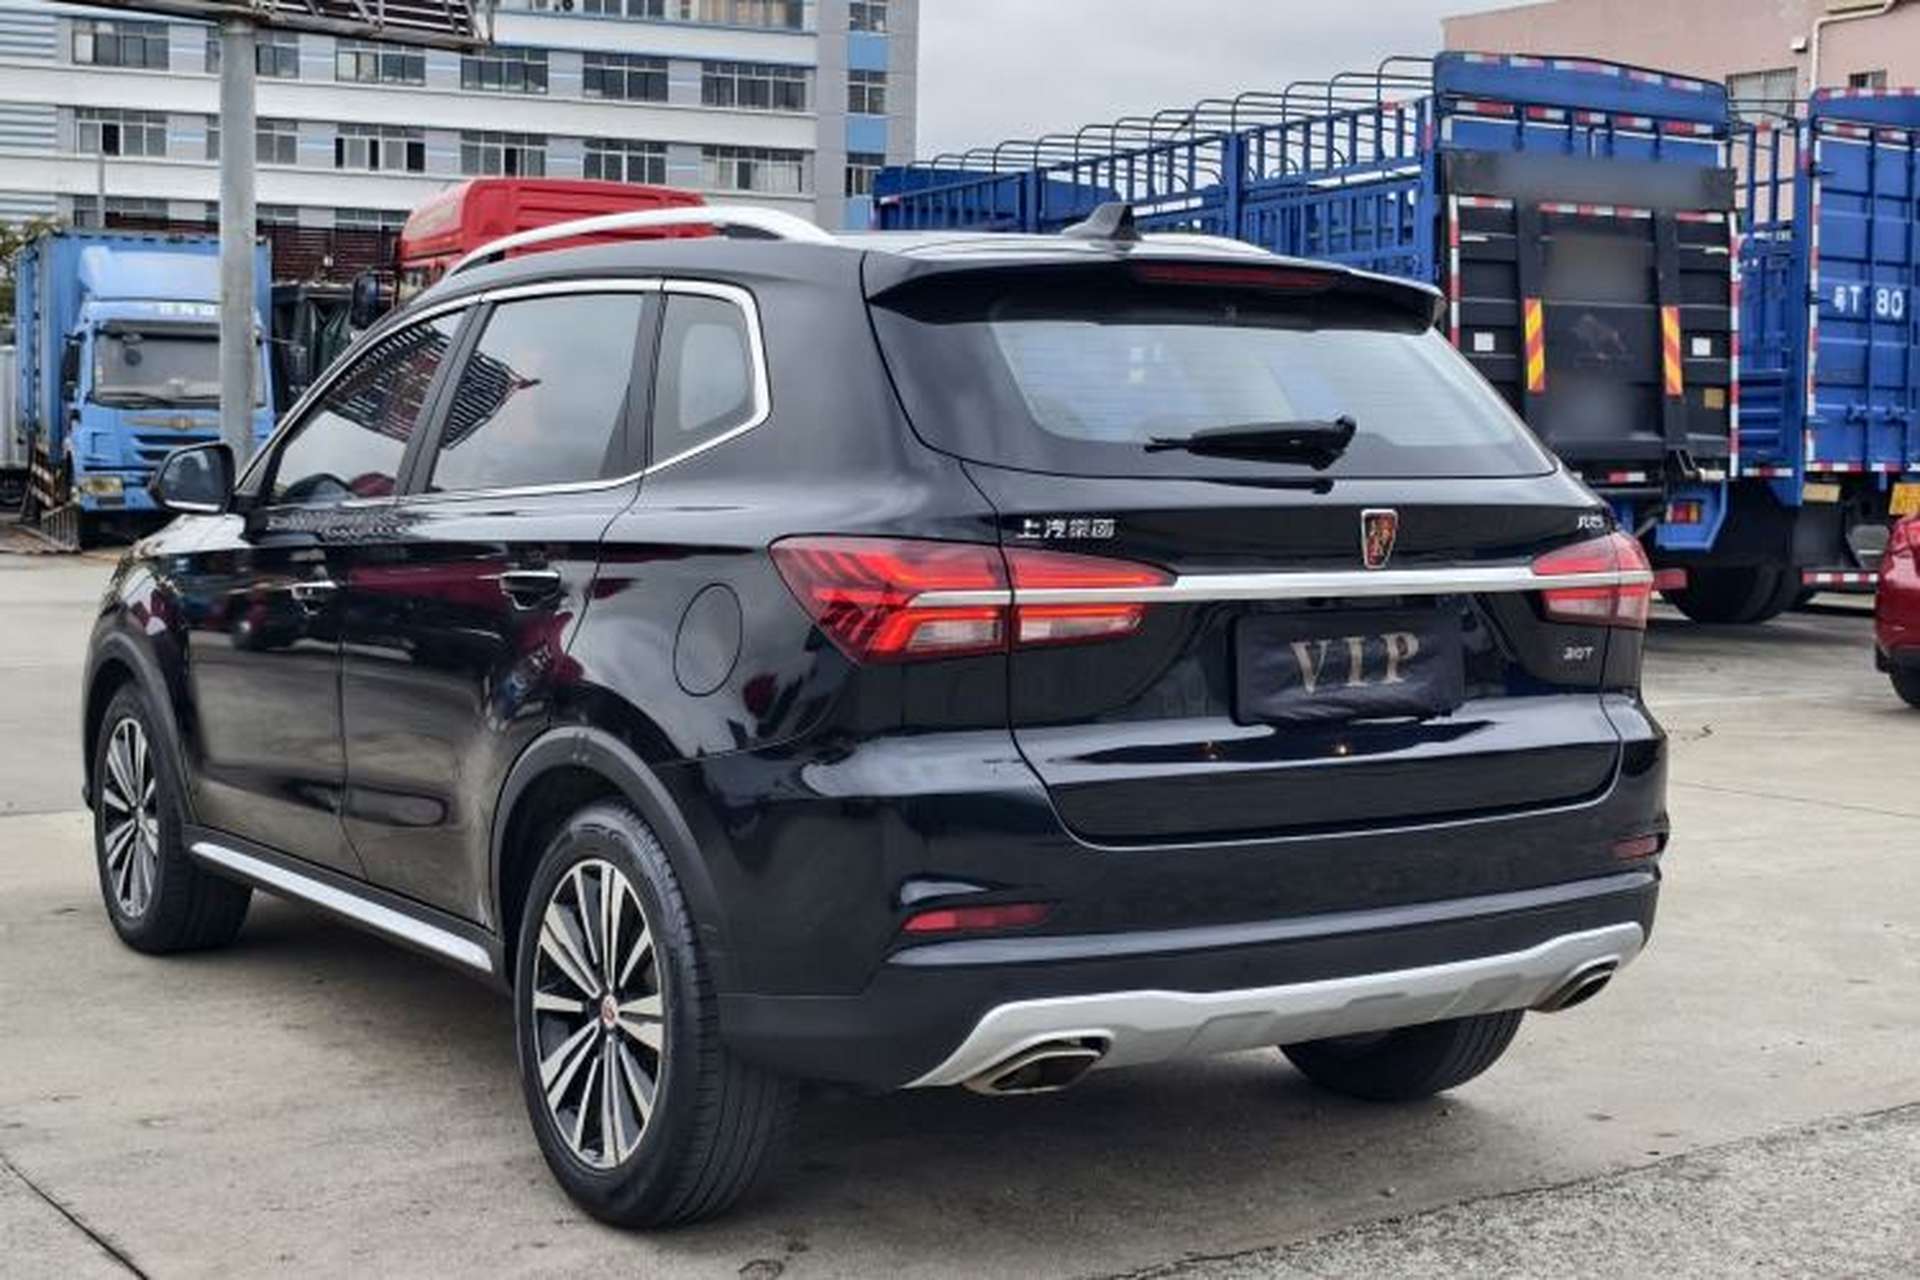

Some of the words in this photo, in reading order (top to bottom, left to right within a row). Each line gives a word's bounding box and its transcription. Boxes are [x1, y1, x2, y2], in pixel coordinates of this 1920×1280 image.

[1876, 288, 1904, 318] 80
[1016, 518, 1115, 539] 上汽集团
[1290, 631, 1419, 693] VIP
